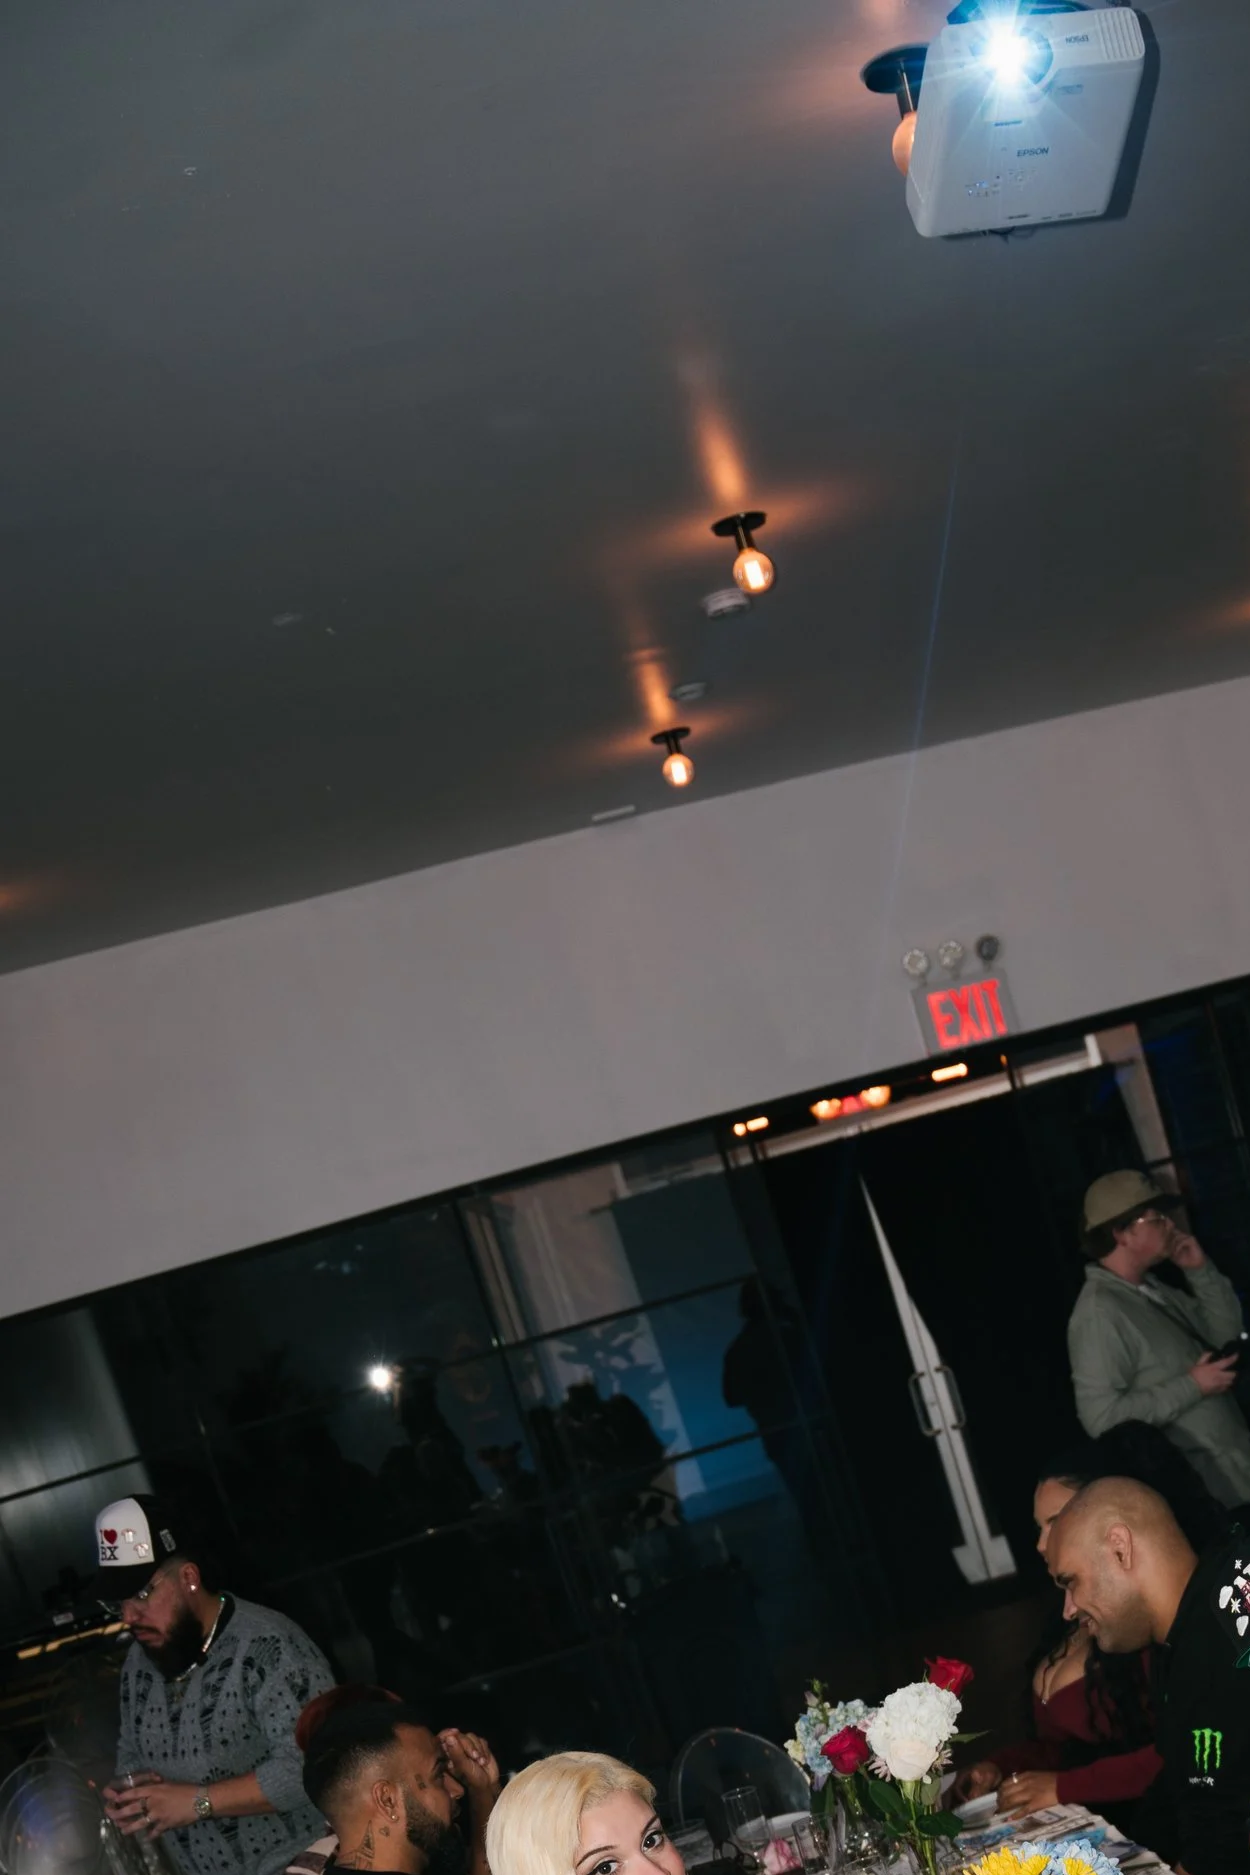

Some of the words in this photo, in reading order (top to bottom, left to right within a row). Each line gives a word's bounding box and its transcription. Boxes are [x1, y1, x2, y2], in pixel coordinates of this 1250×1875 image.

[1016, 147, 1049, 158] EPSON
[927, 978, 1007, 1050] EXIT
[100, 1546, 119, 1561] BX
